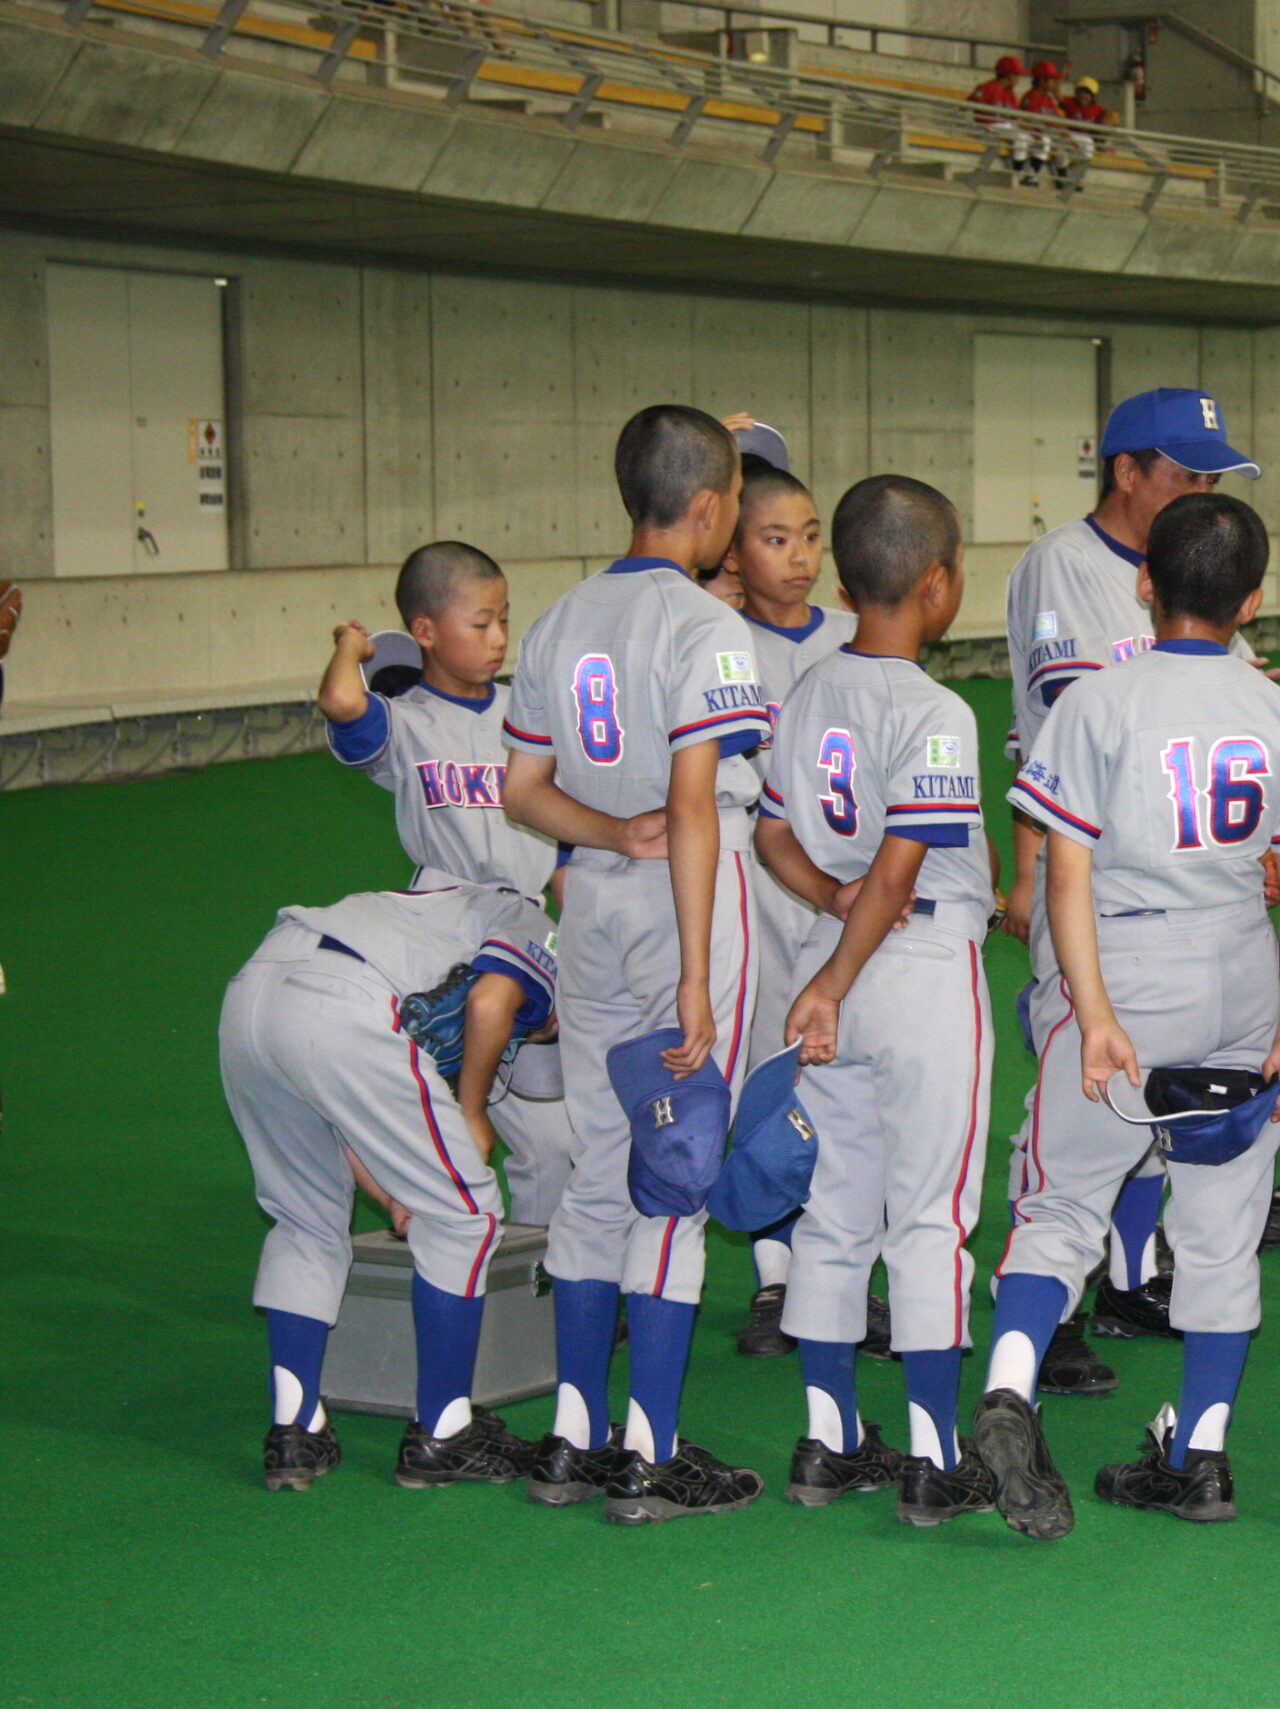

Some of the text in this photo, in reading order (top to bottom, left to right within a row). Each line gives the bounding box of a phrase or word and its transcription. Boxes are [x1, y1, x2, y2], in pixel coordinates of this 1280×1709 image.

[1200, 398, 1220, 430] H
[571, 653, 625, 766] 8
[816, 727, 860, 839] 3
[912, 774, 976, 799] KITAMI
[1160, 735, 1272, 853] 16
[652, 1096, 677, 1131] H
[786, 1107, 817, 1142] H
